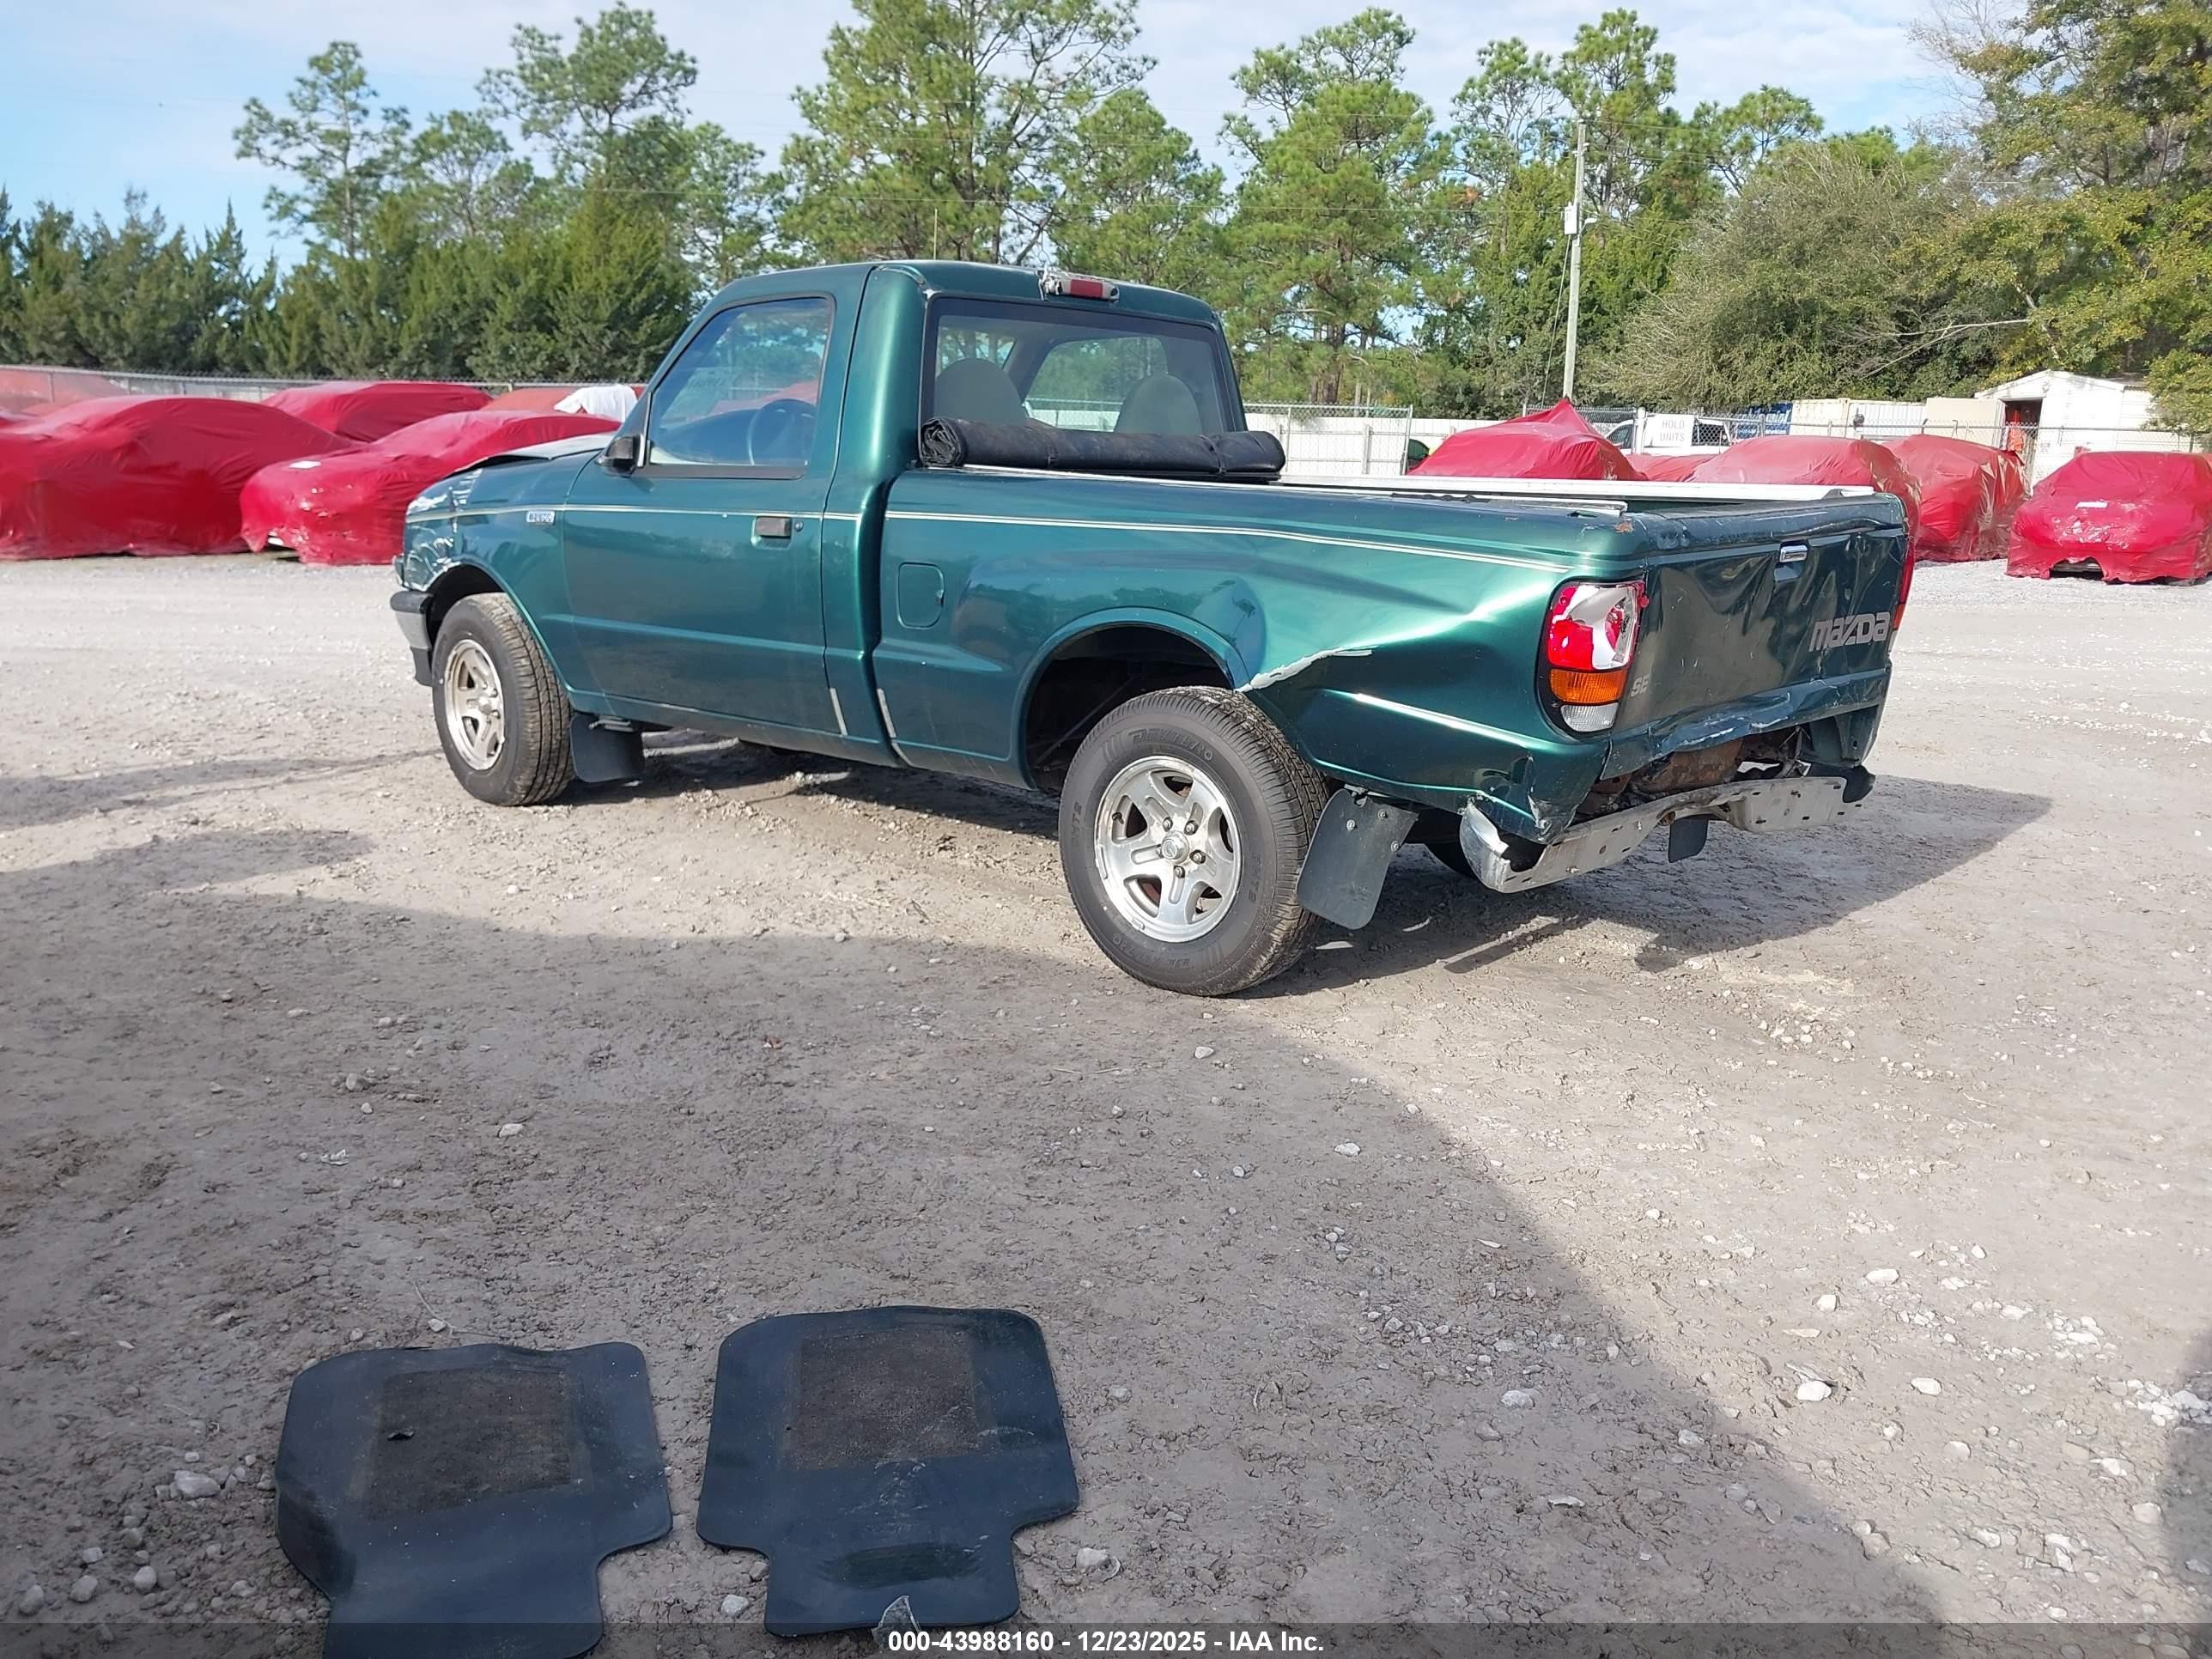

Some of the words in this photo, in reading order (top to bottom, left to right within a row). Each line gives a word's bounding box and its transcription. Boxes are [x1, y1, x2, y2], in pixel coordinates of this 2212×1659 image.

[1662, 419, 1685, 429] HOLD
[1660, 432, 1685, 441] UNITS
[1631, 673, 1650, 697] SE
